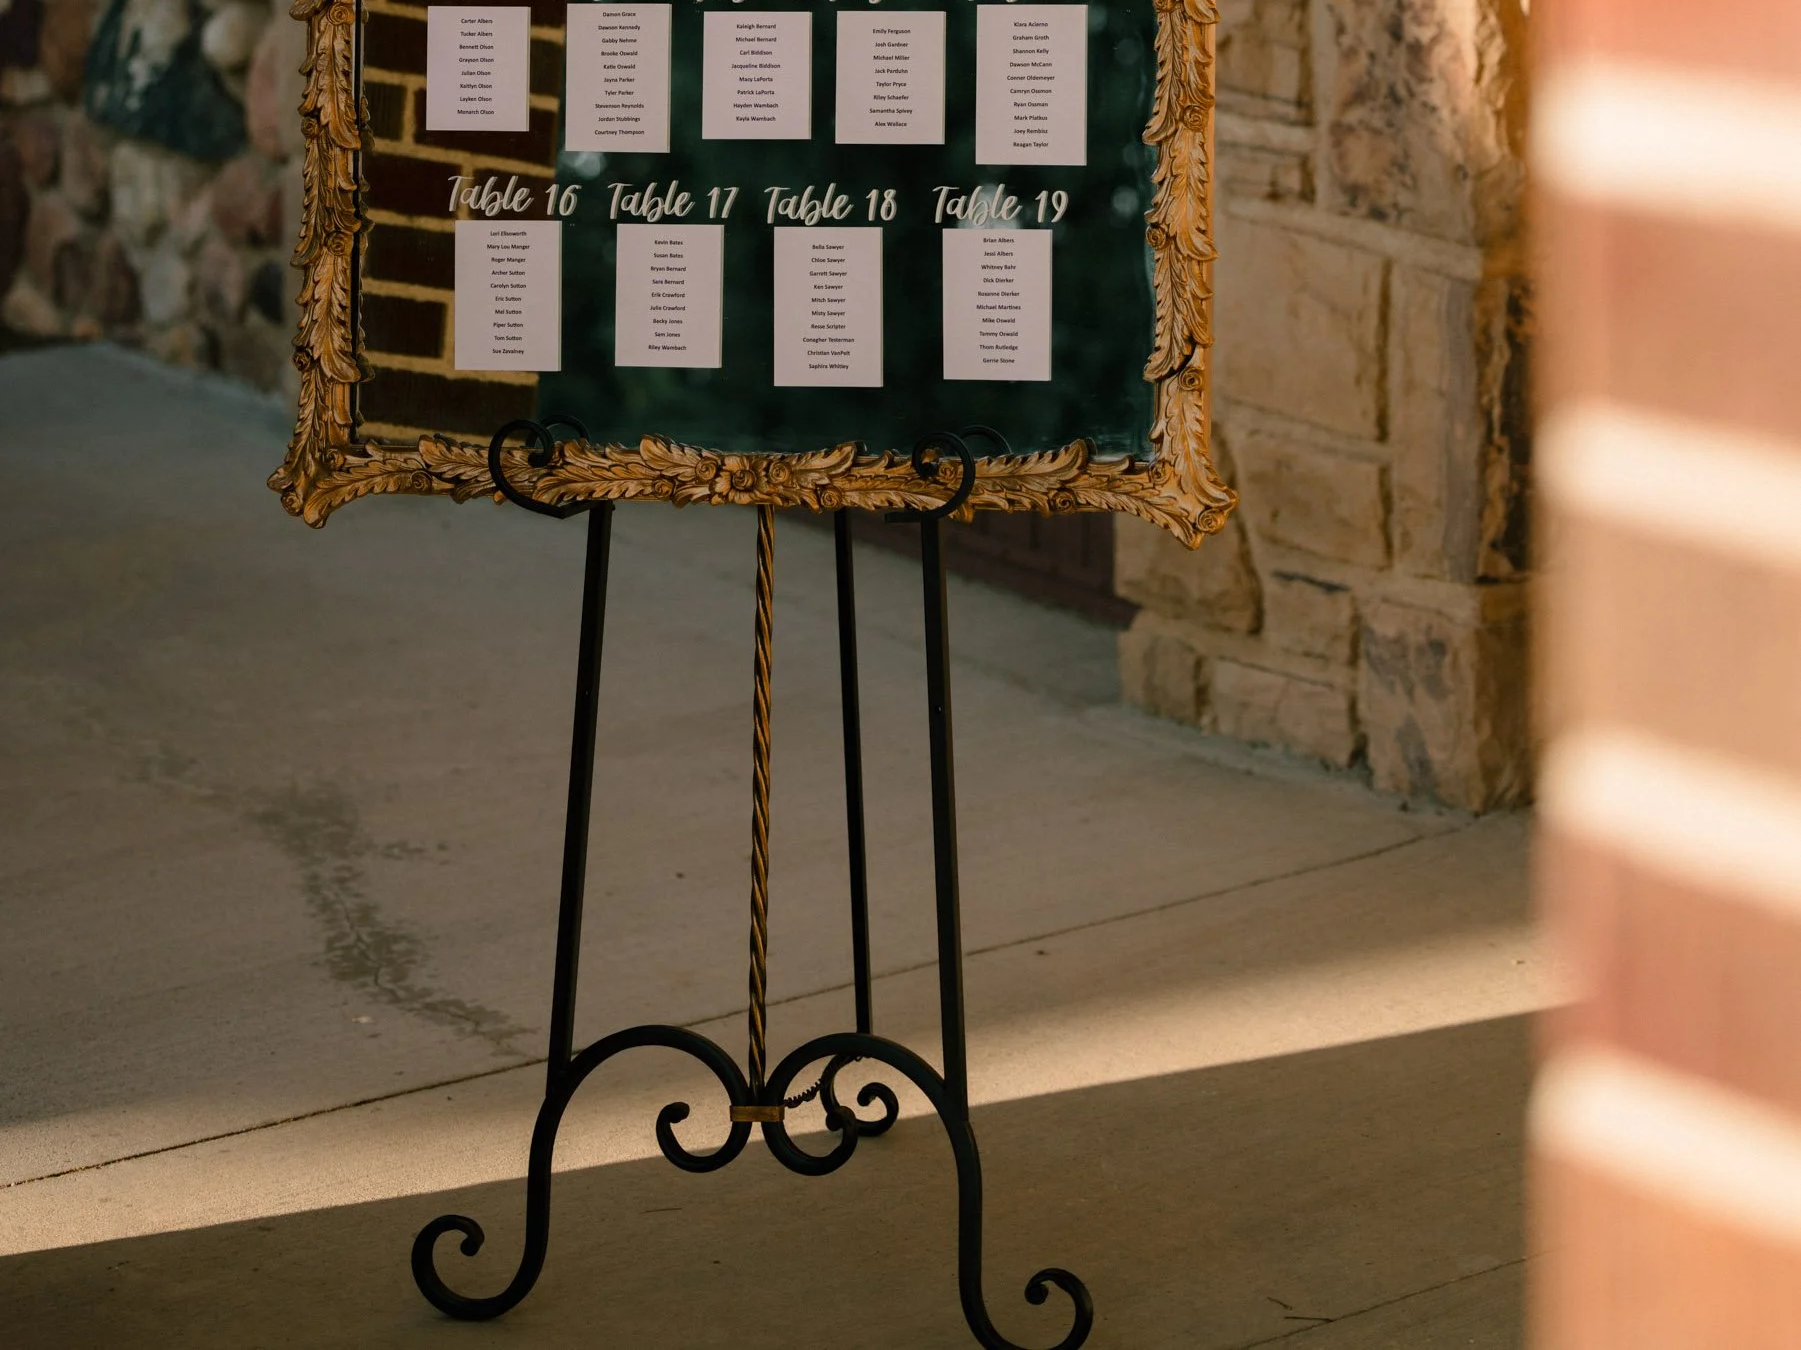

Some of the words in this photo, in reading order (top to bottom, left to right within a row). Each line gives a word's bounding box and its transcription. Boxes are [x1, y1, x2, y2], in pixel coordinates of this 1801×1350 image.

[447, 175, 534, 217] Table
[545, 184, 581, 216] 16
[608, 181, 695, 222] Table
[707, 186, 738, 219] 17
[764, 183, 854, 226] Table
[866, 189, 897, 221] 18
[933, 184, 1023, 226] Table
[1036, 190, 1069, 223] 19
